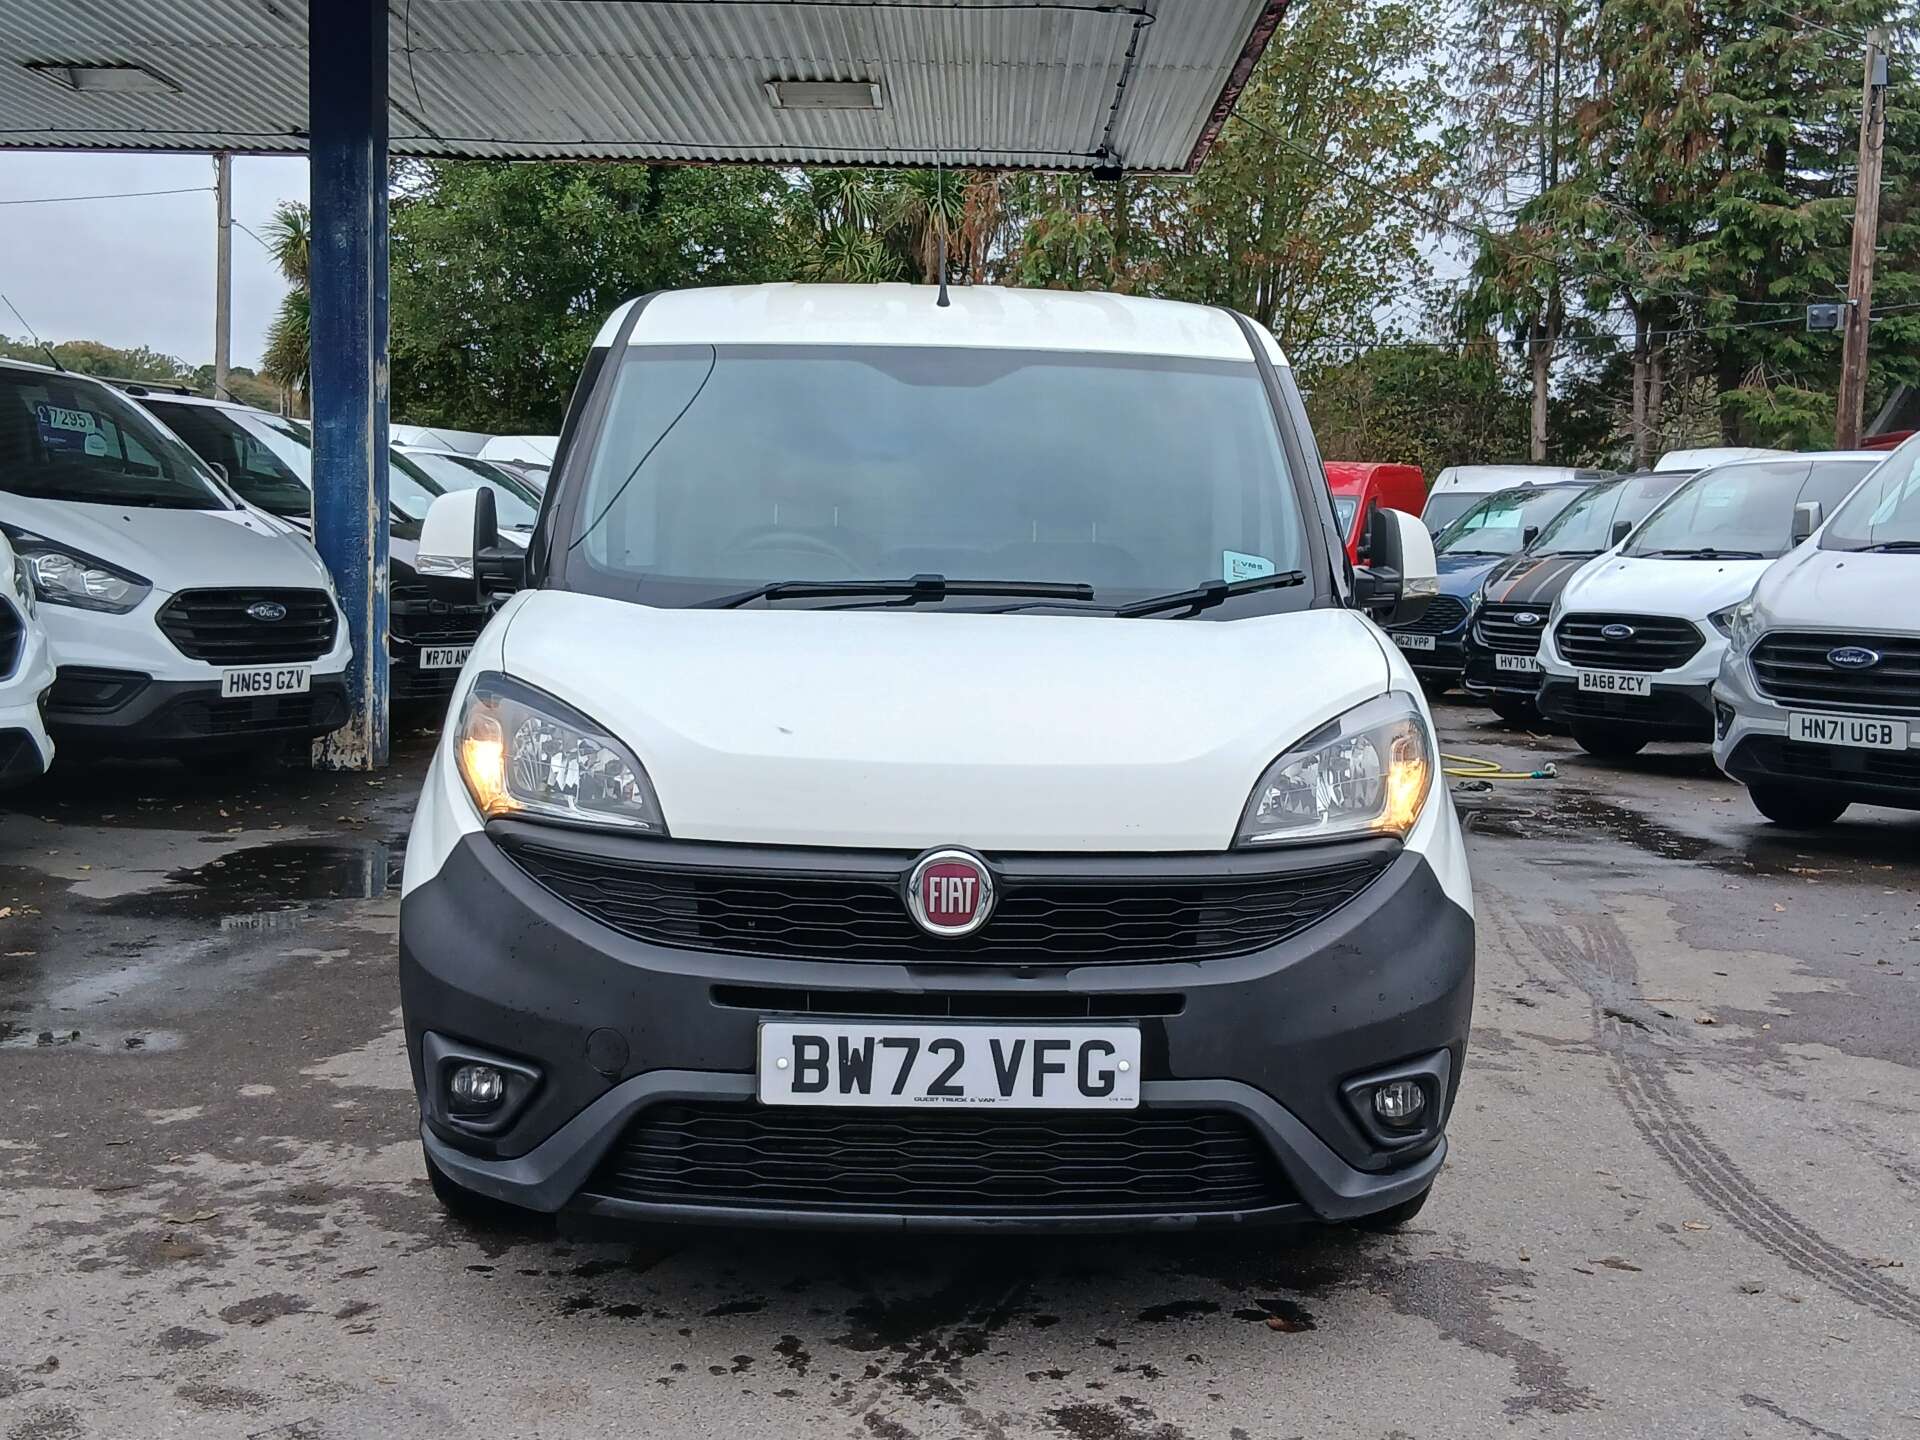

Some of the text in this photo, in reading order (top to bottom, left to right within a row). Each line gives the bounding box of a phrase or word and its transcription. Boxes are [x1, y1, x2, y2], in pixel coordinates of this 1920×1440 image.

[426, 649, 472, 665] WR70 AN
[1500, 655, 1527, 669] HV70
[229, 669, 304, 693] HN69 GZV
[1583, 673, 1645, 693] BA68 ZCY
[1801, 718, 1893, 744] HN71 UGB
[928, 876, 976, 914] FIAT
[791, 1034, 1116, 1098] BW72 VFG
